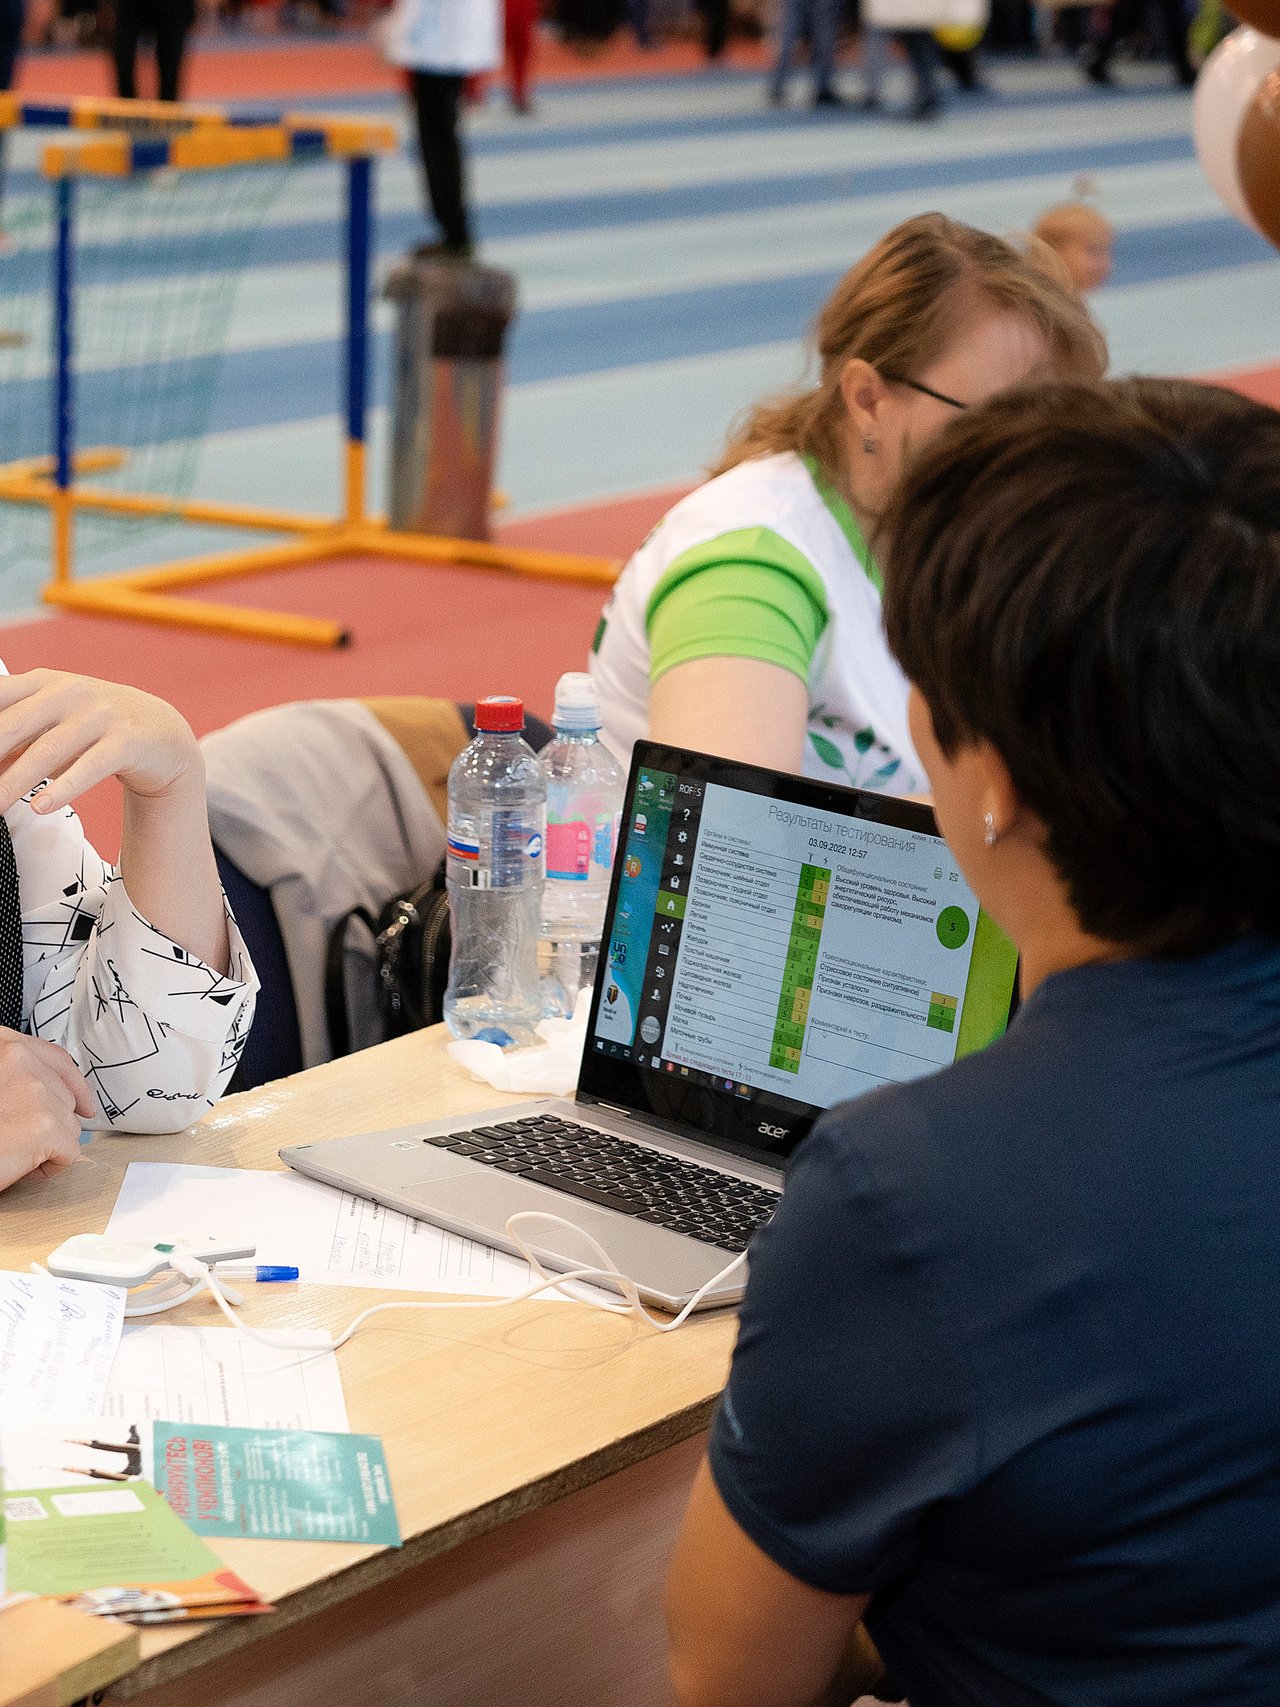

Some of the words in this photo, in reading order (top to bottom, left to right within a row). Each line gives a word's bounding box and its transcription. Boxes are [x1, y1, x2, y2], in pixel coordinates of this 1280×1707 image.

[767, 804, 833, 836] Результаты
[834, 823, 916, 856] тестирования
[701, 840, 727, 853] Иммунная
[728, 848, 749, 858] система
[808, 837, 846, 854] 03.09.2022
[847, 846, 867, 859] 12:57
[699, 852, 754, 872] Сердечно-сосудистая
[755, 867, 776, 877] система
[733, 872, 753, 883] шейный
[754, 879, 769, 888] отдел
[730, 884, 751, 896] грудной
[752, 891, 767, 900] отдел
[833, 884, 876, 900] энергетический
[835, 874, 859, 887] Высокий
[859, 882, 882, 894] уровень
[911, 894, 936, 906] Высокий
[691, 898, 710, 909] Бронхи
[728, 896, 760, 910] поясничный
[760, 905, 776, 914] отдел
[830, 901, 872, 917] саморегуляции
[832, 892, 879, 910] обеспечивающий
[880, 904, 899, 915] работу
[900, 910, 933, 923] механизмов
[689, 910, 707, 920] Легкие
[687, 921, 706, 932] Печень
[949, 921, 956, 932] 5
[685, 933, 708, 945] Желудок
[683, 943, 704, 956] Толстый
[681, 956, 722, 974] Поджелудочная
[722, 969, 741, 979] железа
[712, 978, 731, 988] железа
[818, 973, 841, 986] Признак
[841, 980, 869, 994] усталости
[820, 962, 852, 978] Стрессовое
[853, 972, 881, 985] состояние
[881, 980, 919, 997] (ситуативное)
[676, 991, 692, 1001] Почки
[816, 985, 842, 999] Признаки
[870, 1000, 926, 1023] раздражительности
[674, 1002, 696, 1015] Мочевой
[672, 1015, 688, 1025] Матка
[810, 1017, 847, 1034] Комментарий
[641, 1024, 660, 1036] START
[670, 1026, 696, 1039] Маточные
[696, 1034, 712, 1045] трубы
[665, 1049, 681, 1060] Время
[689, 1057, 720, 1073] следующего
[721, 1068, 733, 1076] теста
[757, 1121, 790, 1139] acer
